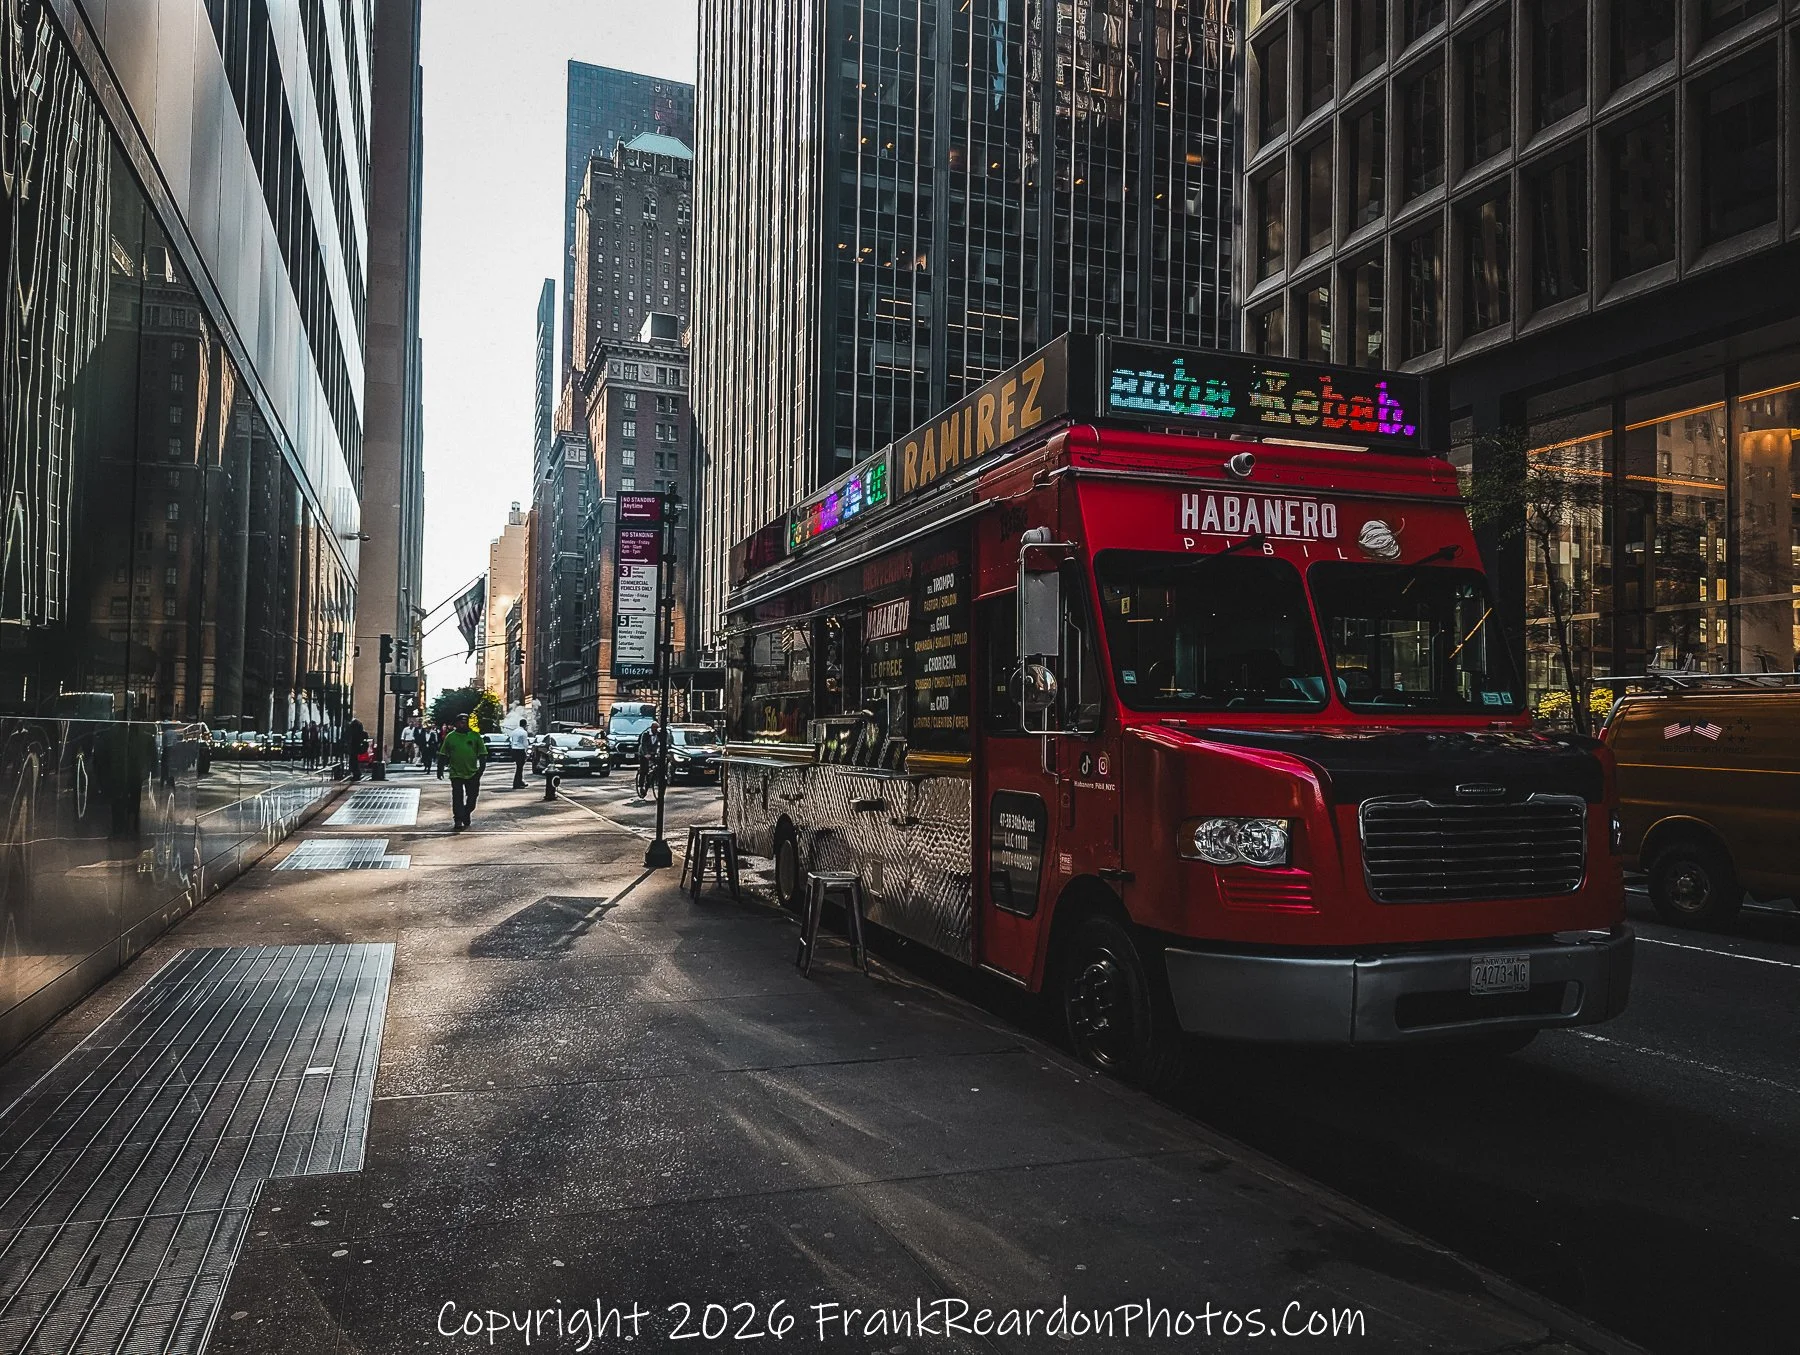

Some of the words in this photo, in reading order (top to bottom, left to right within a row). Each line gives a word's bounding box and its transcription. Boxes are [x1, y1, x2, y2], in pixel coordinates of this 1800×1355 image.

[904, 358, 1045, 493] RAMIREZ
[1181, 493, 1338, 538] HABANERO
[1183, 537, 1348, 560] PIBIL
[621, 566, 629, 576] 3
[933, 573, 955, 592] TROMPO
[620, 616, 627, 626] 5
[866, 600, 910, 640] HABANERO
[936, 615, 950, 631] GRILL
[954, 632, 968, 645] POLLO
[870, 662, 878, 679] LE
[878, 659, 903, 678] OFRECE
[928, 654, 956, 672] CHORICERA
[936, 695, 949, 710] CAZO
[999, 813, 1012, 828] 47-38
[1022, 816, 1036, 832] Street
[1015, 834, 1028, 850] 11101
